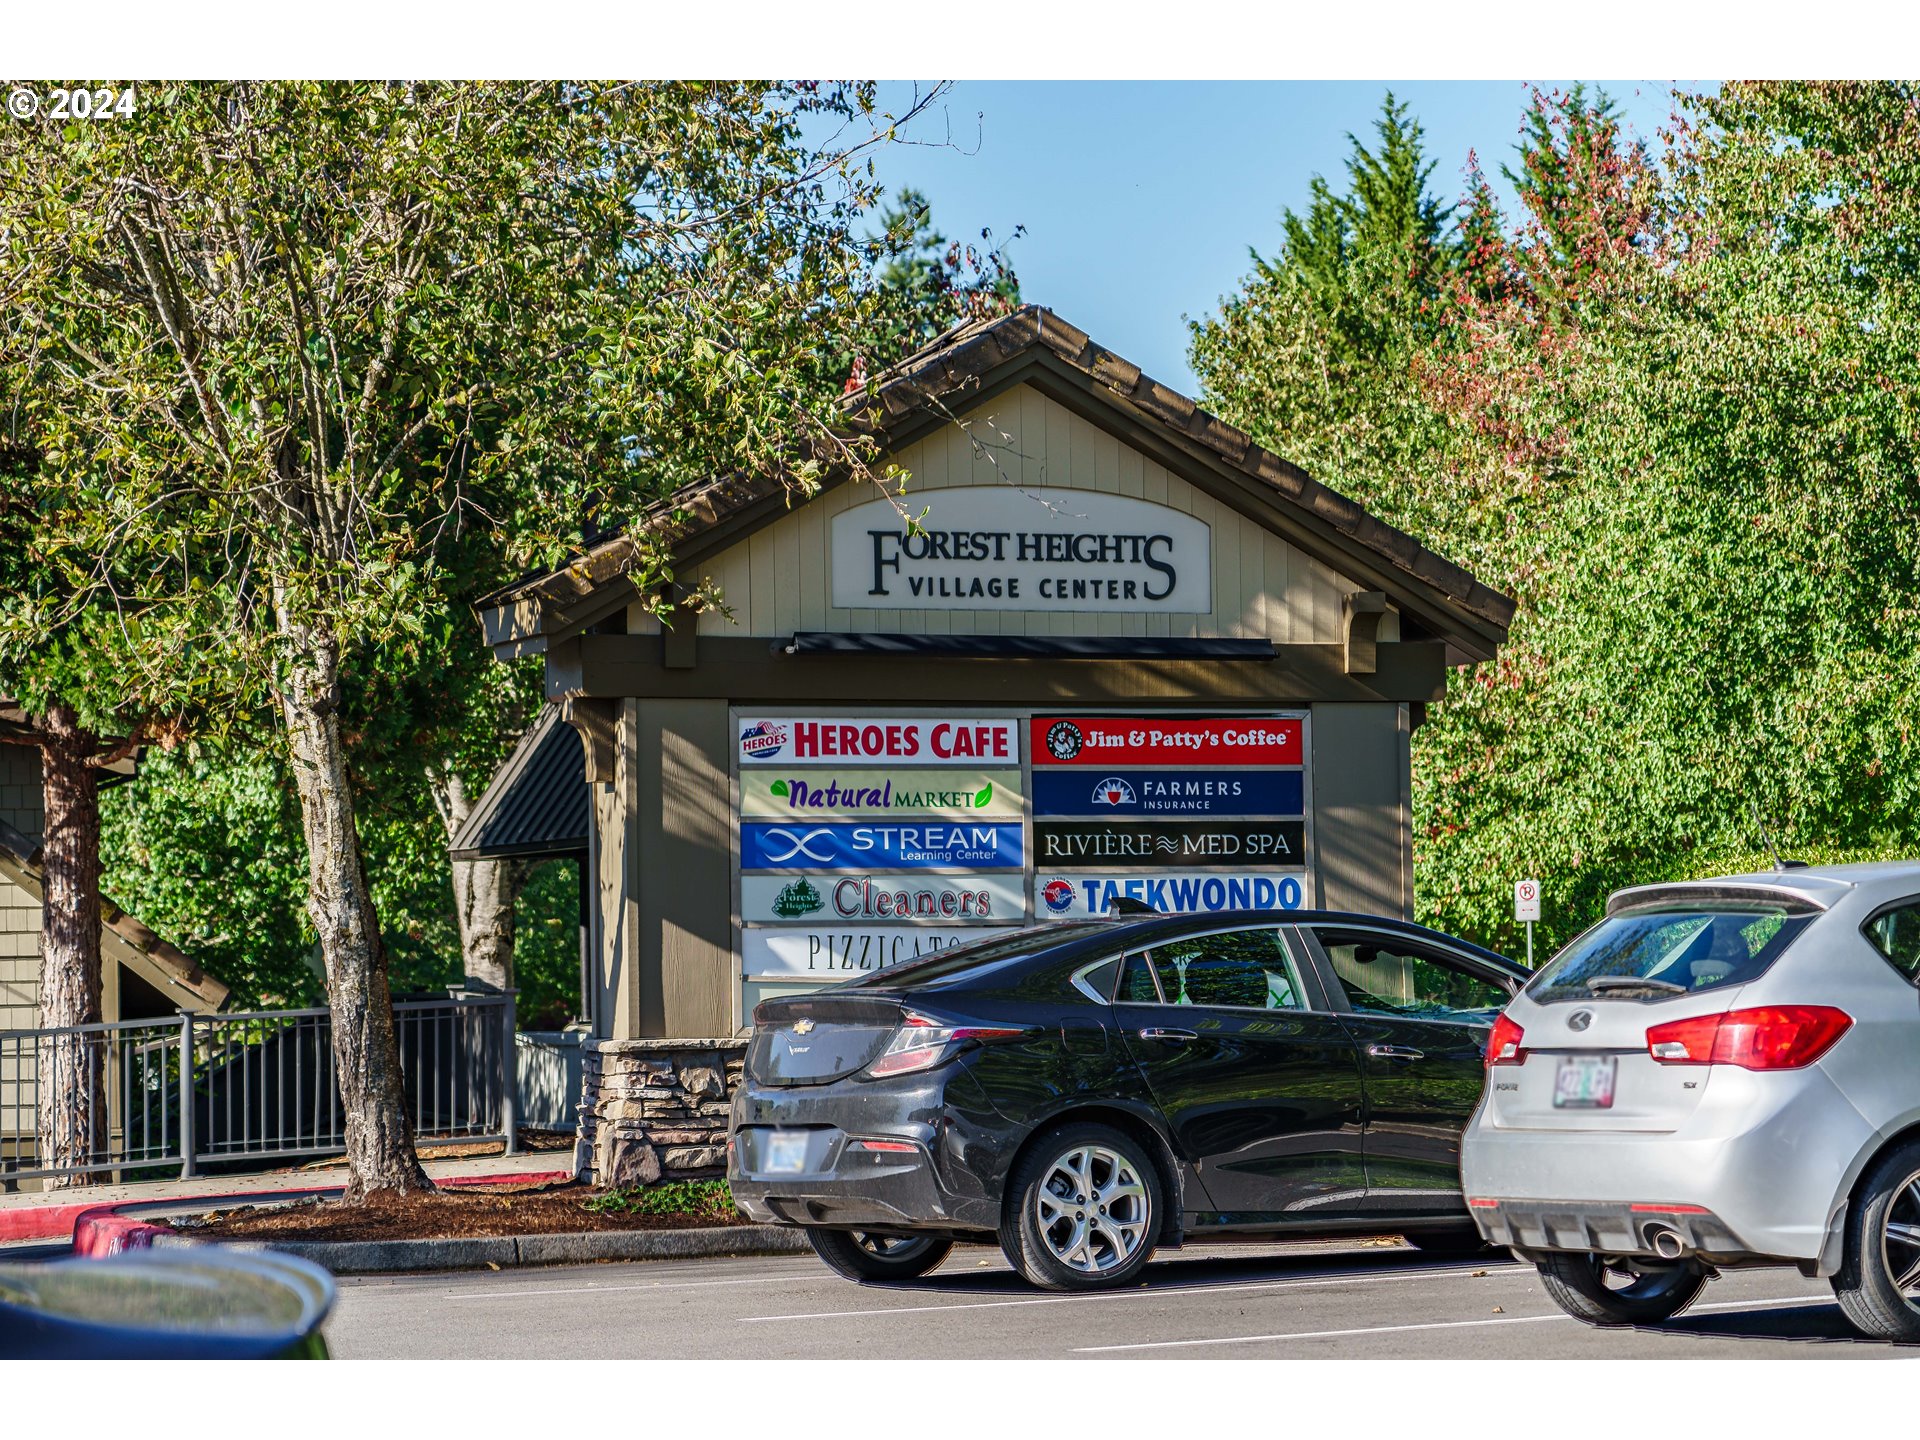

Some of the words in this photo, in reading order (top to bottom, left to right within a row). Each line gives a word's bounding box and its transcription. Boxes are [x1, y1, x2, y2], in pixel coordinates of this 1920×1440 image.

[867, 530, 1010, 595] FOREST
[1016, 533, 1177, 600] HEIGHTS
[908, 576, 1019, 598] VILLAGE
[1039, 578, 1137, 599] CENTER
[743, 733, 787, 751] HEROES
[794, 722, 919, 757] HEROES
[930, 723, 1009, 758] CAFE
[1085, 730, 1125, 747] Jim
[1128, 731, 1146, 747] &
[1149, 730, 1219, 750] Patty's
[1222, 729, 1287, 746] Coffee
[788, 779, 891, 808] Natural
[894, 791, 974, 807] MARKET
[1144, 781, 1242, 795] FARMERS
[1144, 801, 1210, 809] INSURANCE
[852, 828, 998, 849] STREAM
[1044, 829, 1153, 856] RIVIÈRE
[1183, 834, 1240, 855] MED
[1246, 834, 1290, 855] SPA
[900, 850, 951, 861] Learning
[956, 850, 997, 860] Center
[832, 875, 991, 918] Cleaners
[808, 935, 961, 971] PIZZICAT
